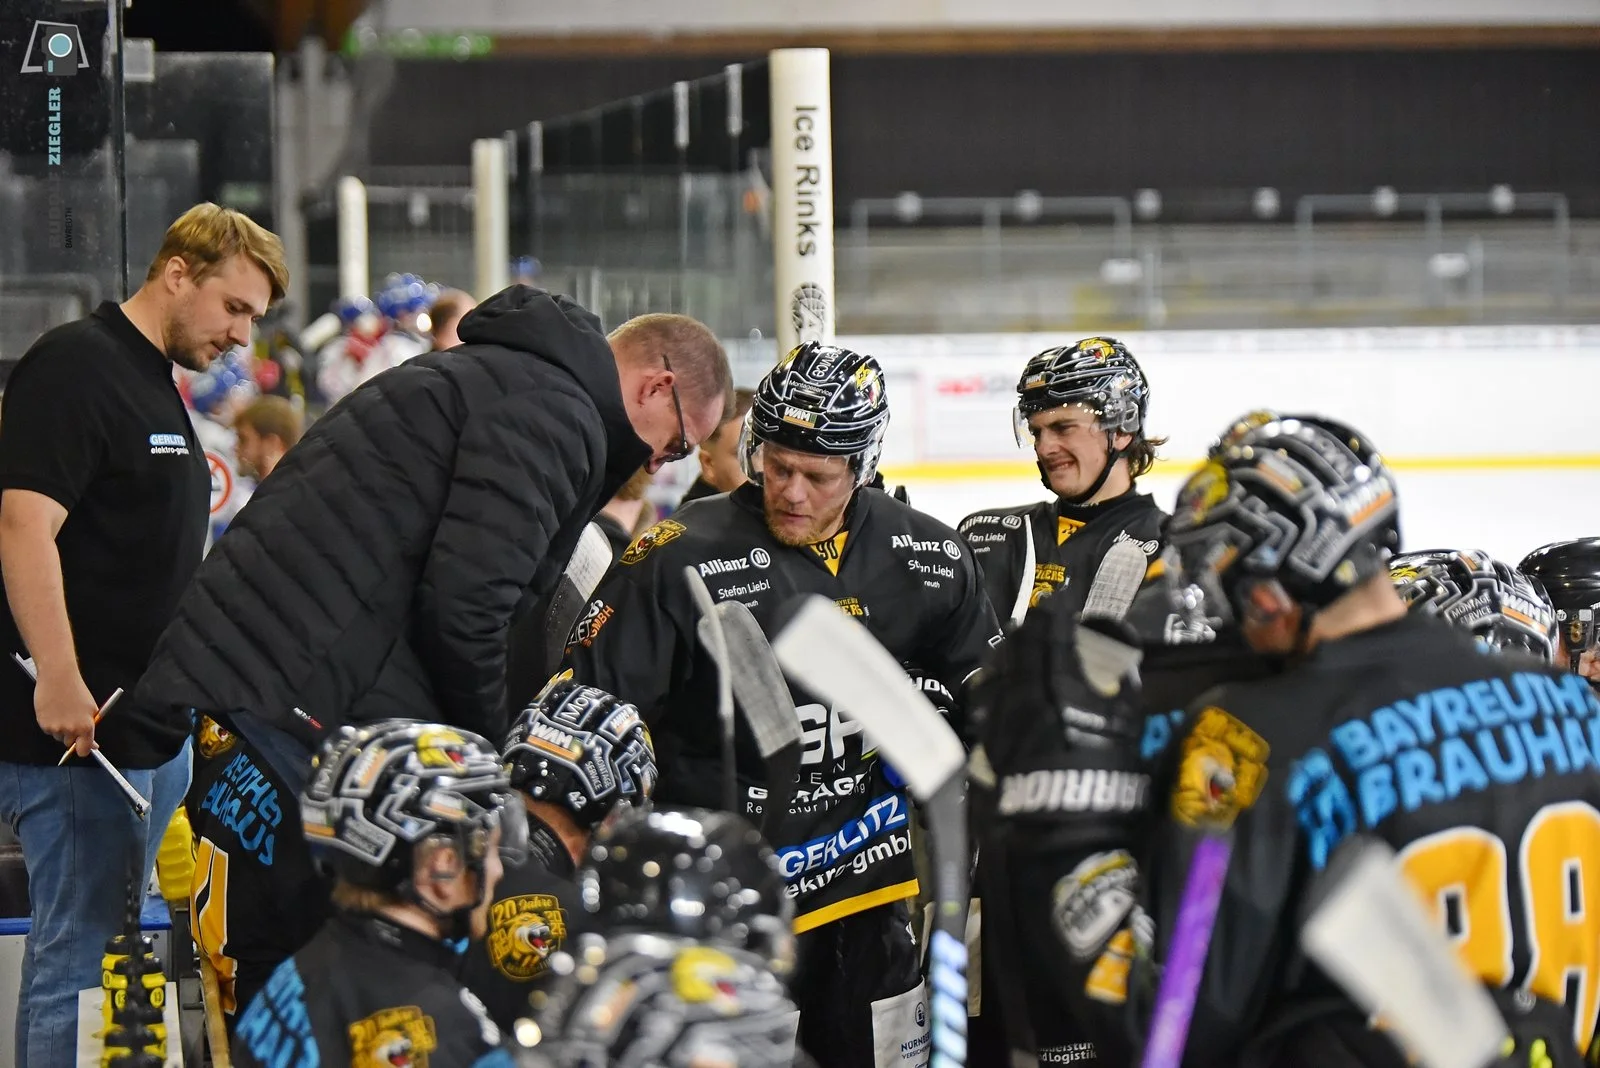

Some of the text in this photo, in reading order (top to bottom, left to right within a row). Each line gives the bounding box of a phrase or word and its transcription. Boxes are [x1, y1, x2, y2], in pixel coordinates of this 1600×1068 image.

[794, 105, 821, 256] Ice Rinks
[788, 379, 833, 397] Montageservice
[784, 406, 811, 422] WAM
[151, 434, 186, 446] GERLITZ
[892, 534, 941, 553] Allianz
[968, 532, 1006, 542] fan Liebl
[700, 556, 750, 578] Allianz
[933, 564, 955, 579] Liebl
[718, 579, 771, 600] Stefan Liebl
[924, 578, 941, 589] reuth
[744, 599, 759, 609] reuth
[1451, 590, 1492, 619] MONTAGE
[590, 604, 615, 638] GMBH
[1330, 671, 1600, 770] BAYREUTH
[531, 721, 574, 750] WAM
[584, 760, 602, 792] SERVICE
[1357, 717, 1600, 829] BRAUHA
[568, 790, 588, 810] 42
[778, 795, 906, 878] GERLITZ
[1048, 1050, 1097, 1064] Logistik
